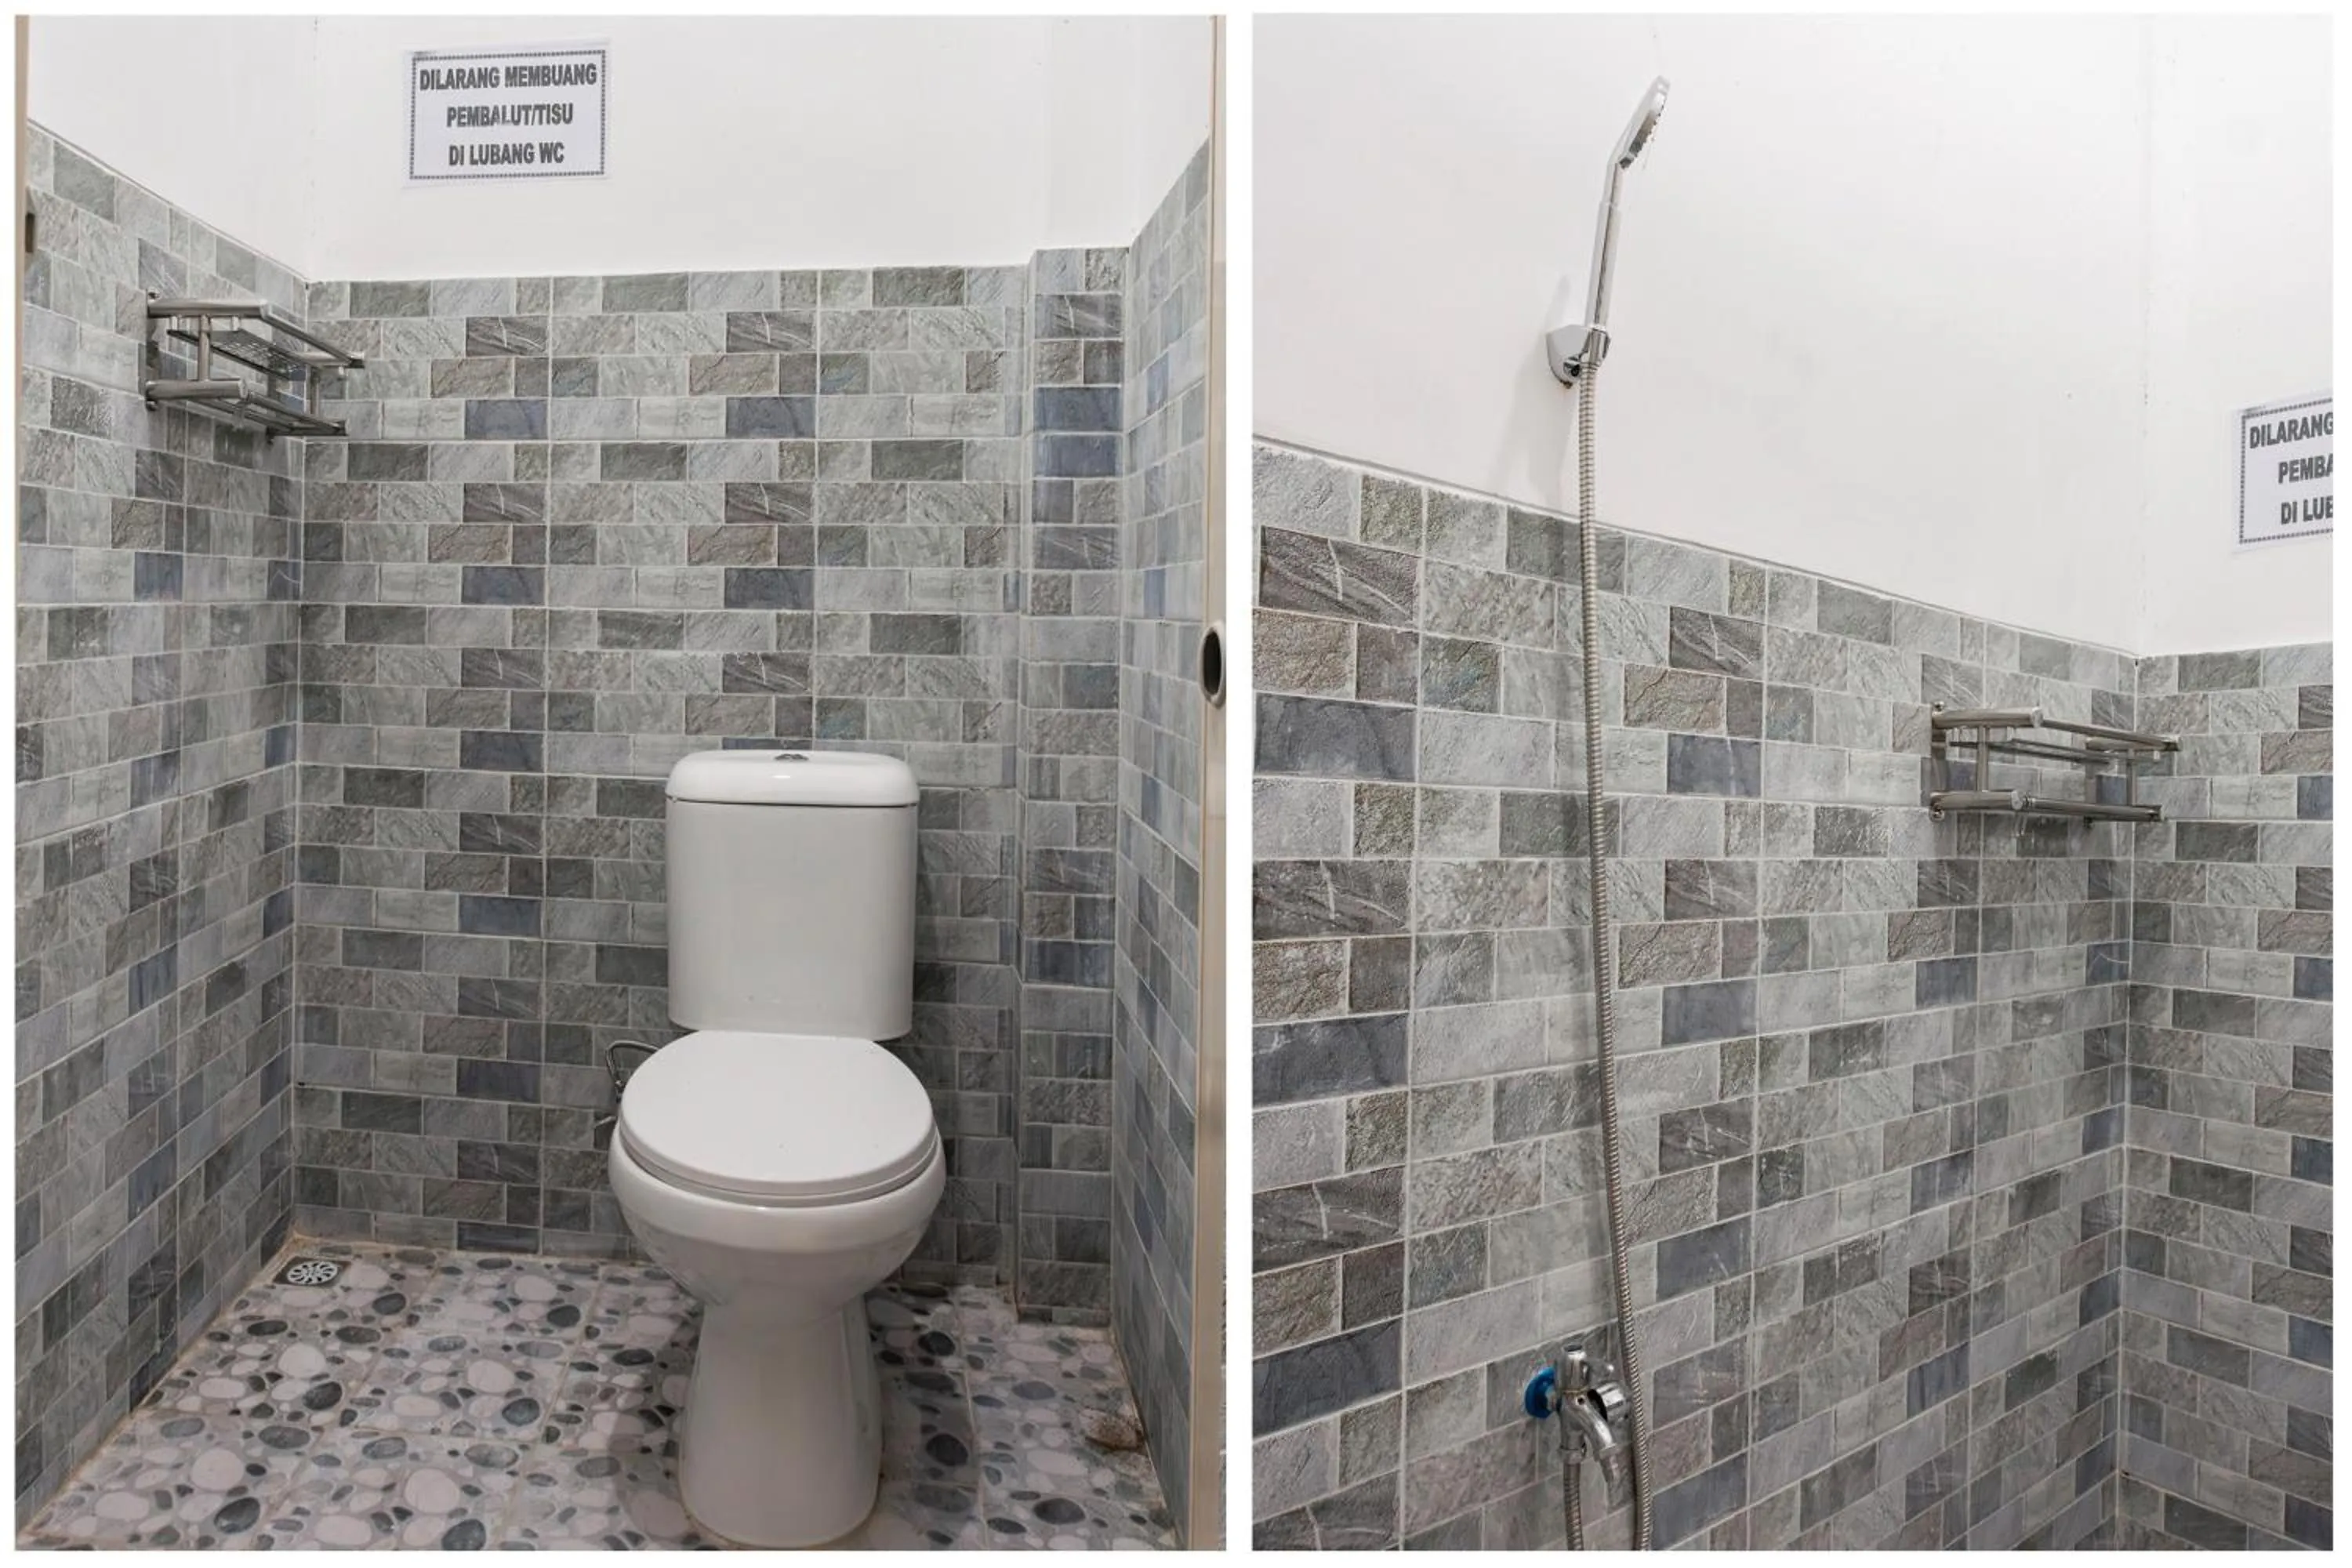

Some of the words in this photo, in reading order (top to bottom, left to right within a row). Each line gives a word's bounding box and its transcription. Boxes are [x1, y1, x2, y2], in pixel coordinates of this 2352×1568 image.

[419, 67, 500, 90] DILARANG
[504, 63, 597, 88] MEMBUANG
[446, 103, 574, 128] PEMBALUT/TISU
[448, 144, 464, 166] DI
[469, 143, 535, 165] LUBANG
[539, 142, 564, 164] WC
[2249, 412, 2333, 448] DILARANG
[2281, 500, 2297, 524] DI
